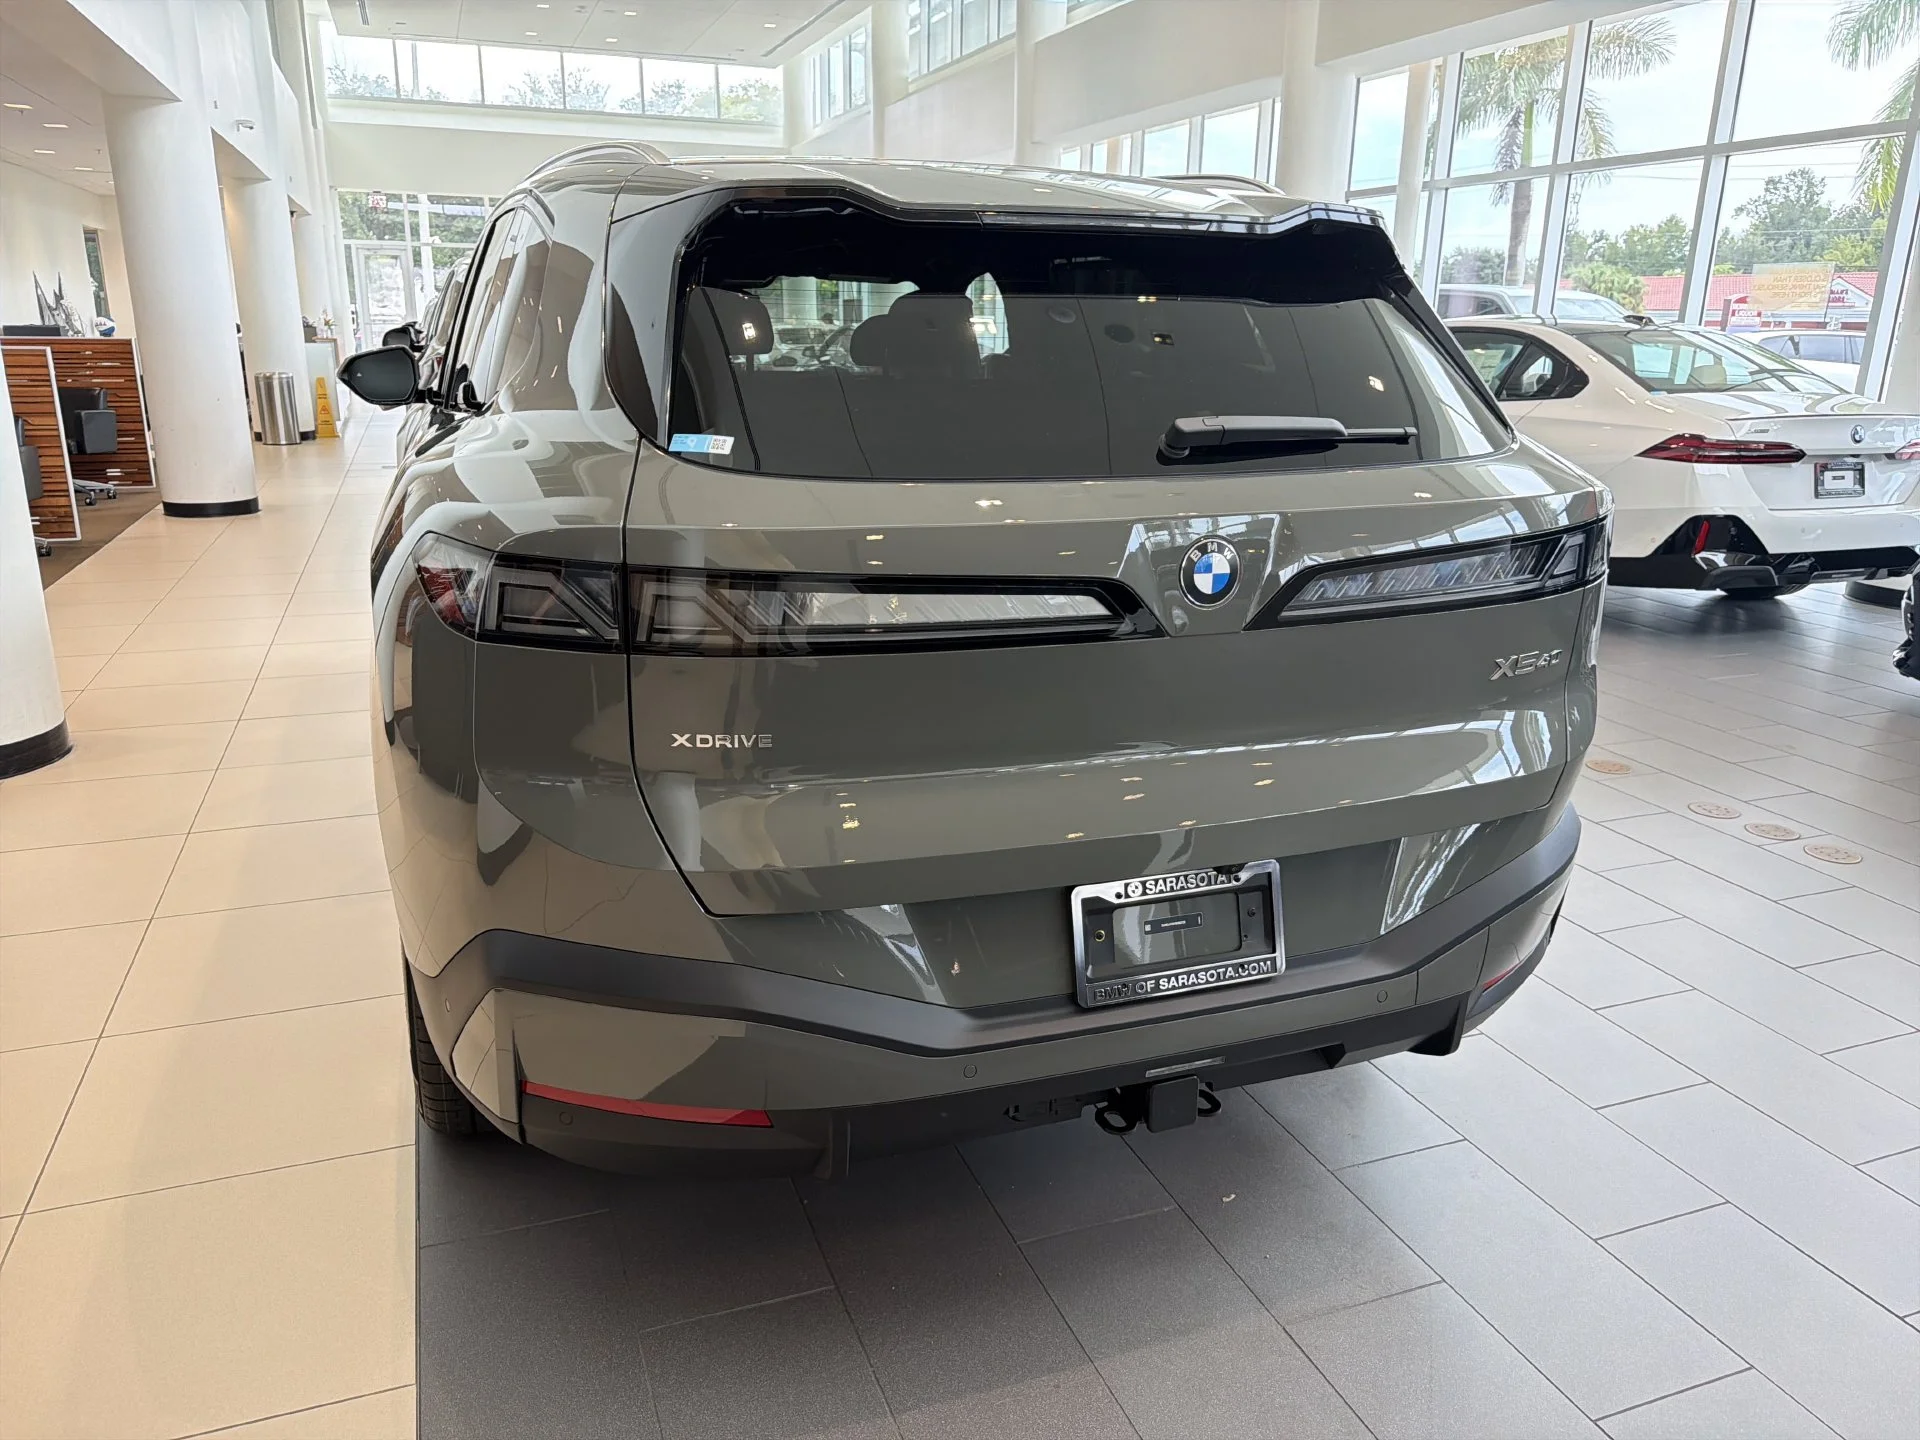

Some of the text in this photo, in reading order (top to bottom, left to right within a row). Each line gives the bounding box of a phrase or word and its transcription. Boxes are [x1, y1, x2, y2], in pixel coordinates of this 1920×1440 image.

[1190, 542, 1233, 562] BMW
[1145, 871, 1227, 895] SARASOTA
[1094, 960, 1272, 1001] BMW OF SARASOTA.COM
